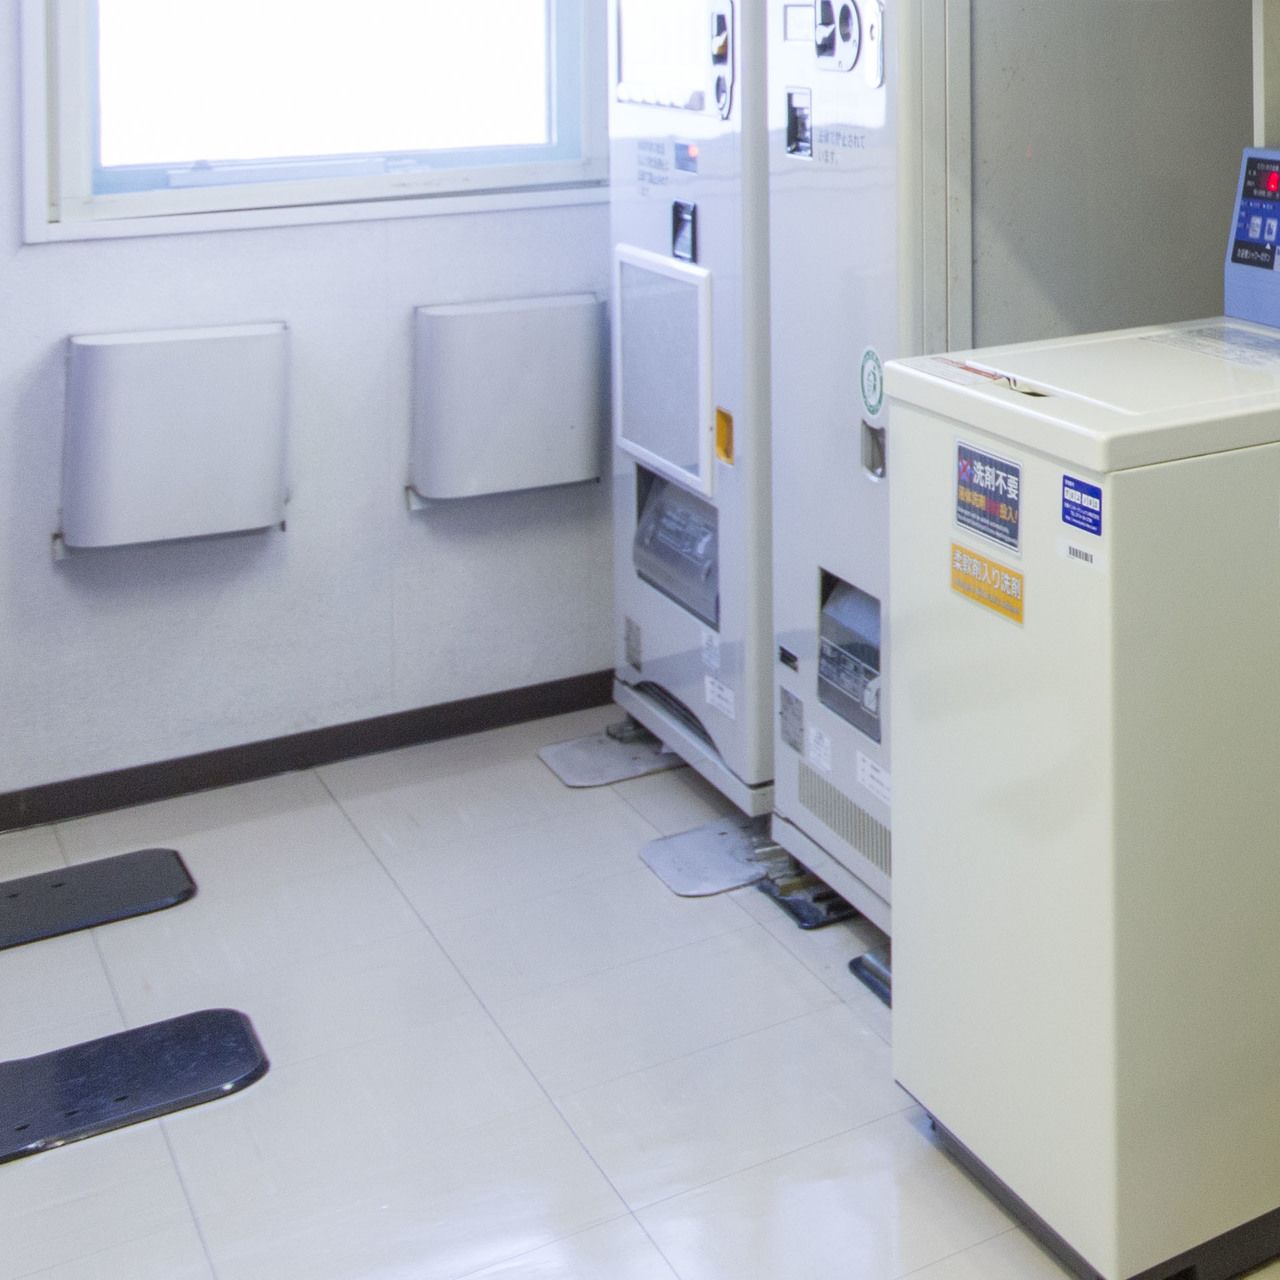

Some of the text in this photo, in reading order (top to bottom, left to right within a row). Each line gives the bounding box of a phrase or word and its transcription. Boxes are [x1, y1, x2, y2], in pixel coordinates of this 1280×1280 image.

[972, 461, 1019, 502] 洗剤不要
[953, 550, 1021, 601] 柔軟剤入り洗剤
